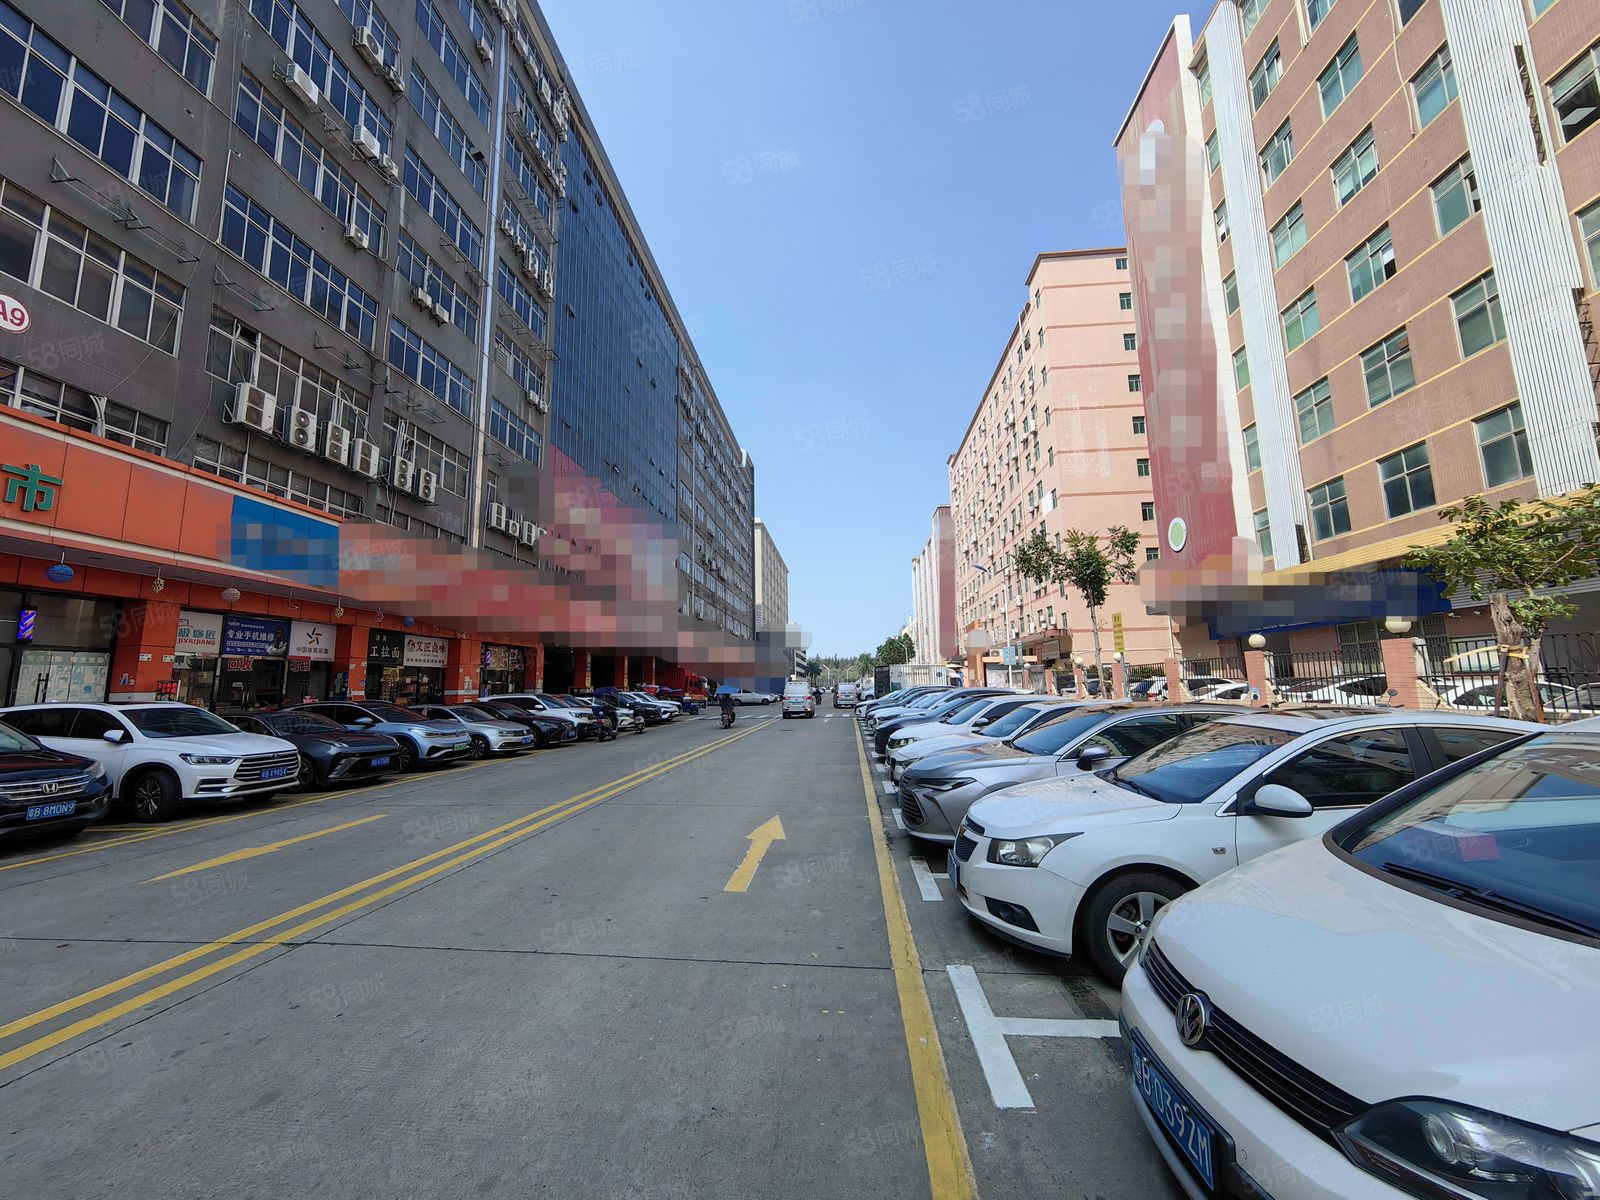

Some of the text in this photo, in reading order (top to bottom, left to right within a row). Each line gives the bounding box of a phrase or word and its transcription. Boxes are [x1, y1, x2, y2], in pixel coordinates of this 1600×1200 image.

[2, 463, 64, 512] 市
[227, 629, 275, 642] 专业手机维修
[227, 658, 254, 671] 回收
